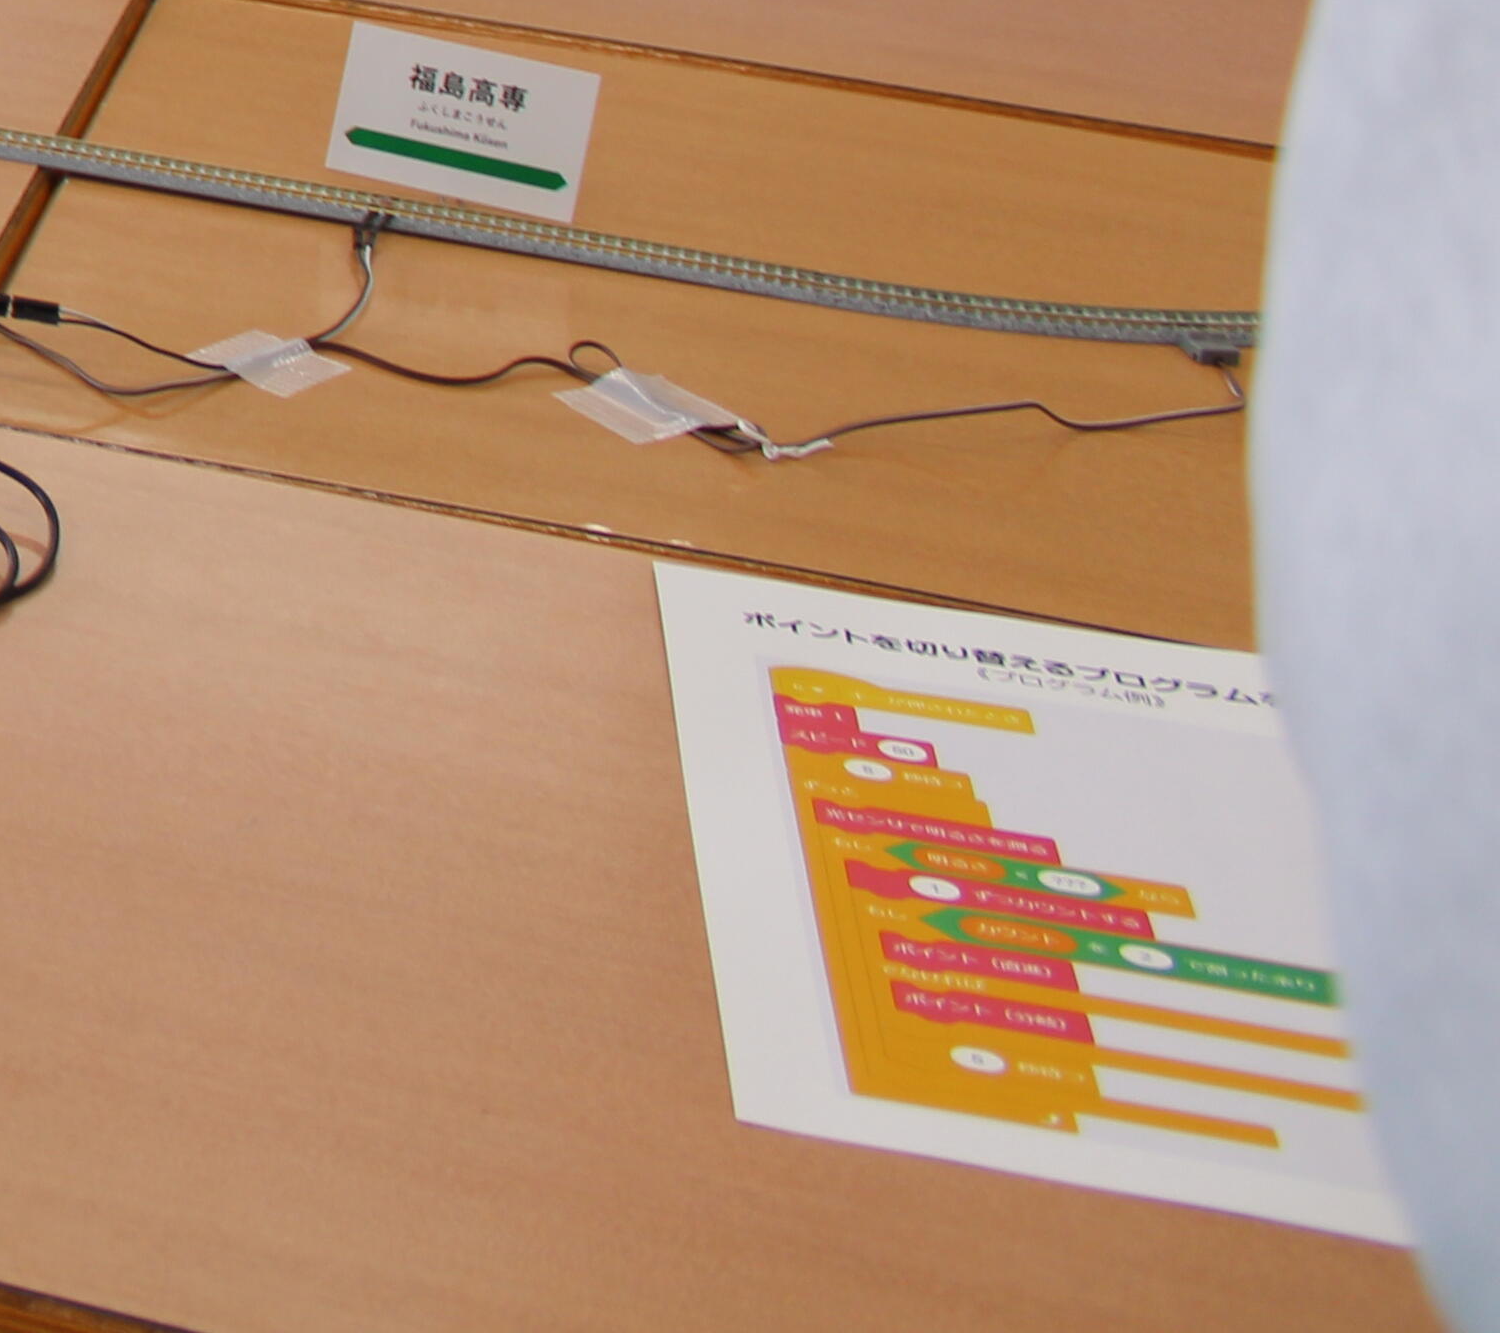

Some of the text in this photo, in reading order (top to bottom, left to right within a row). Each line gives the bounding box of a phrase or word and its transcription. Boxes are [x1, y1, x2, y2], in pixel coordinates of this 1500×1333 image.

[409, 63, 528, 113] 福島高専
[410, 118, 471, 141] Fukushima
